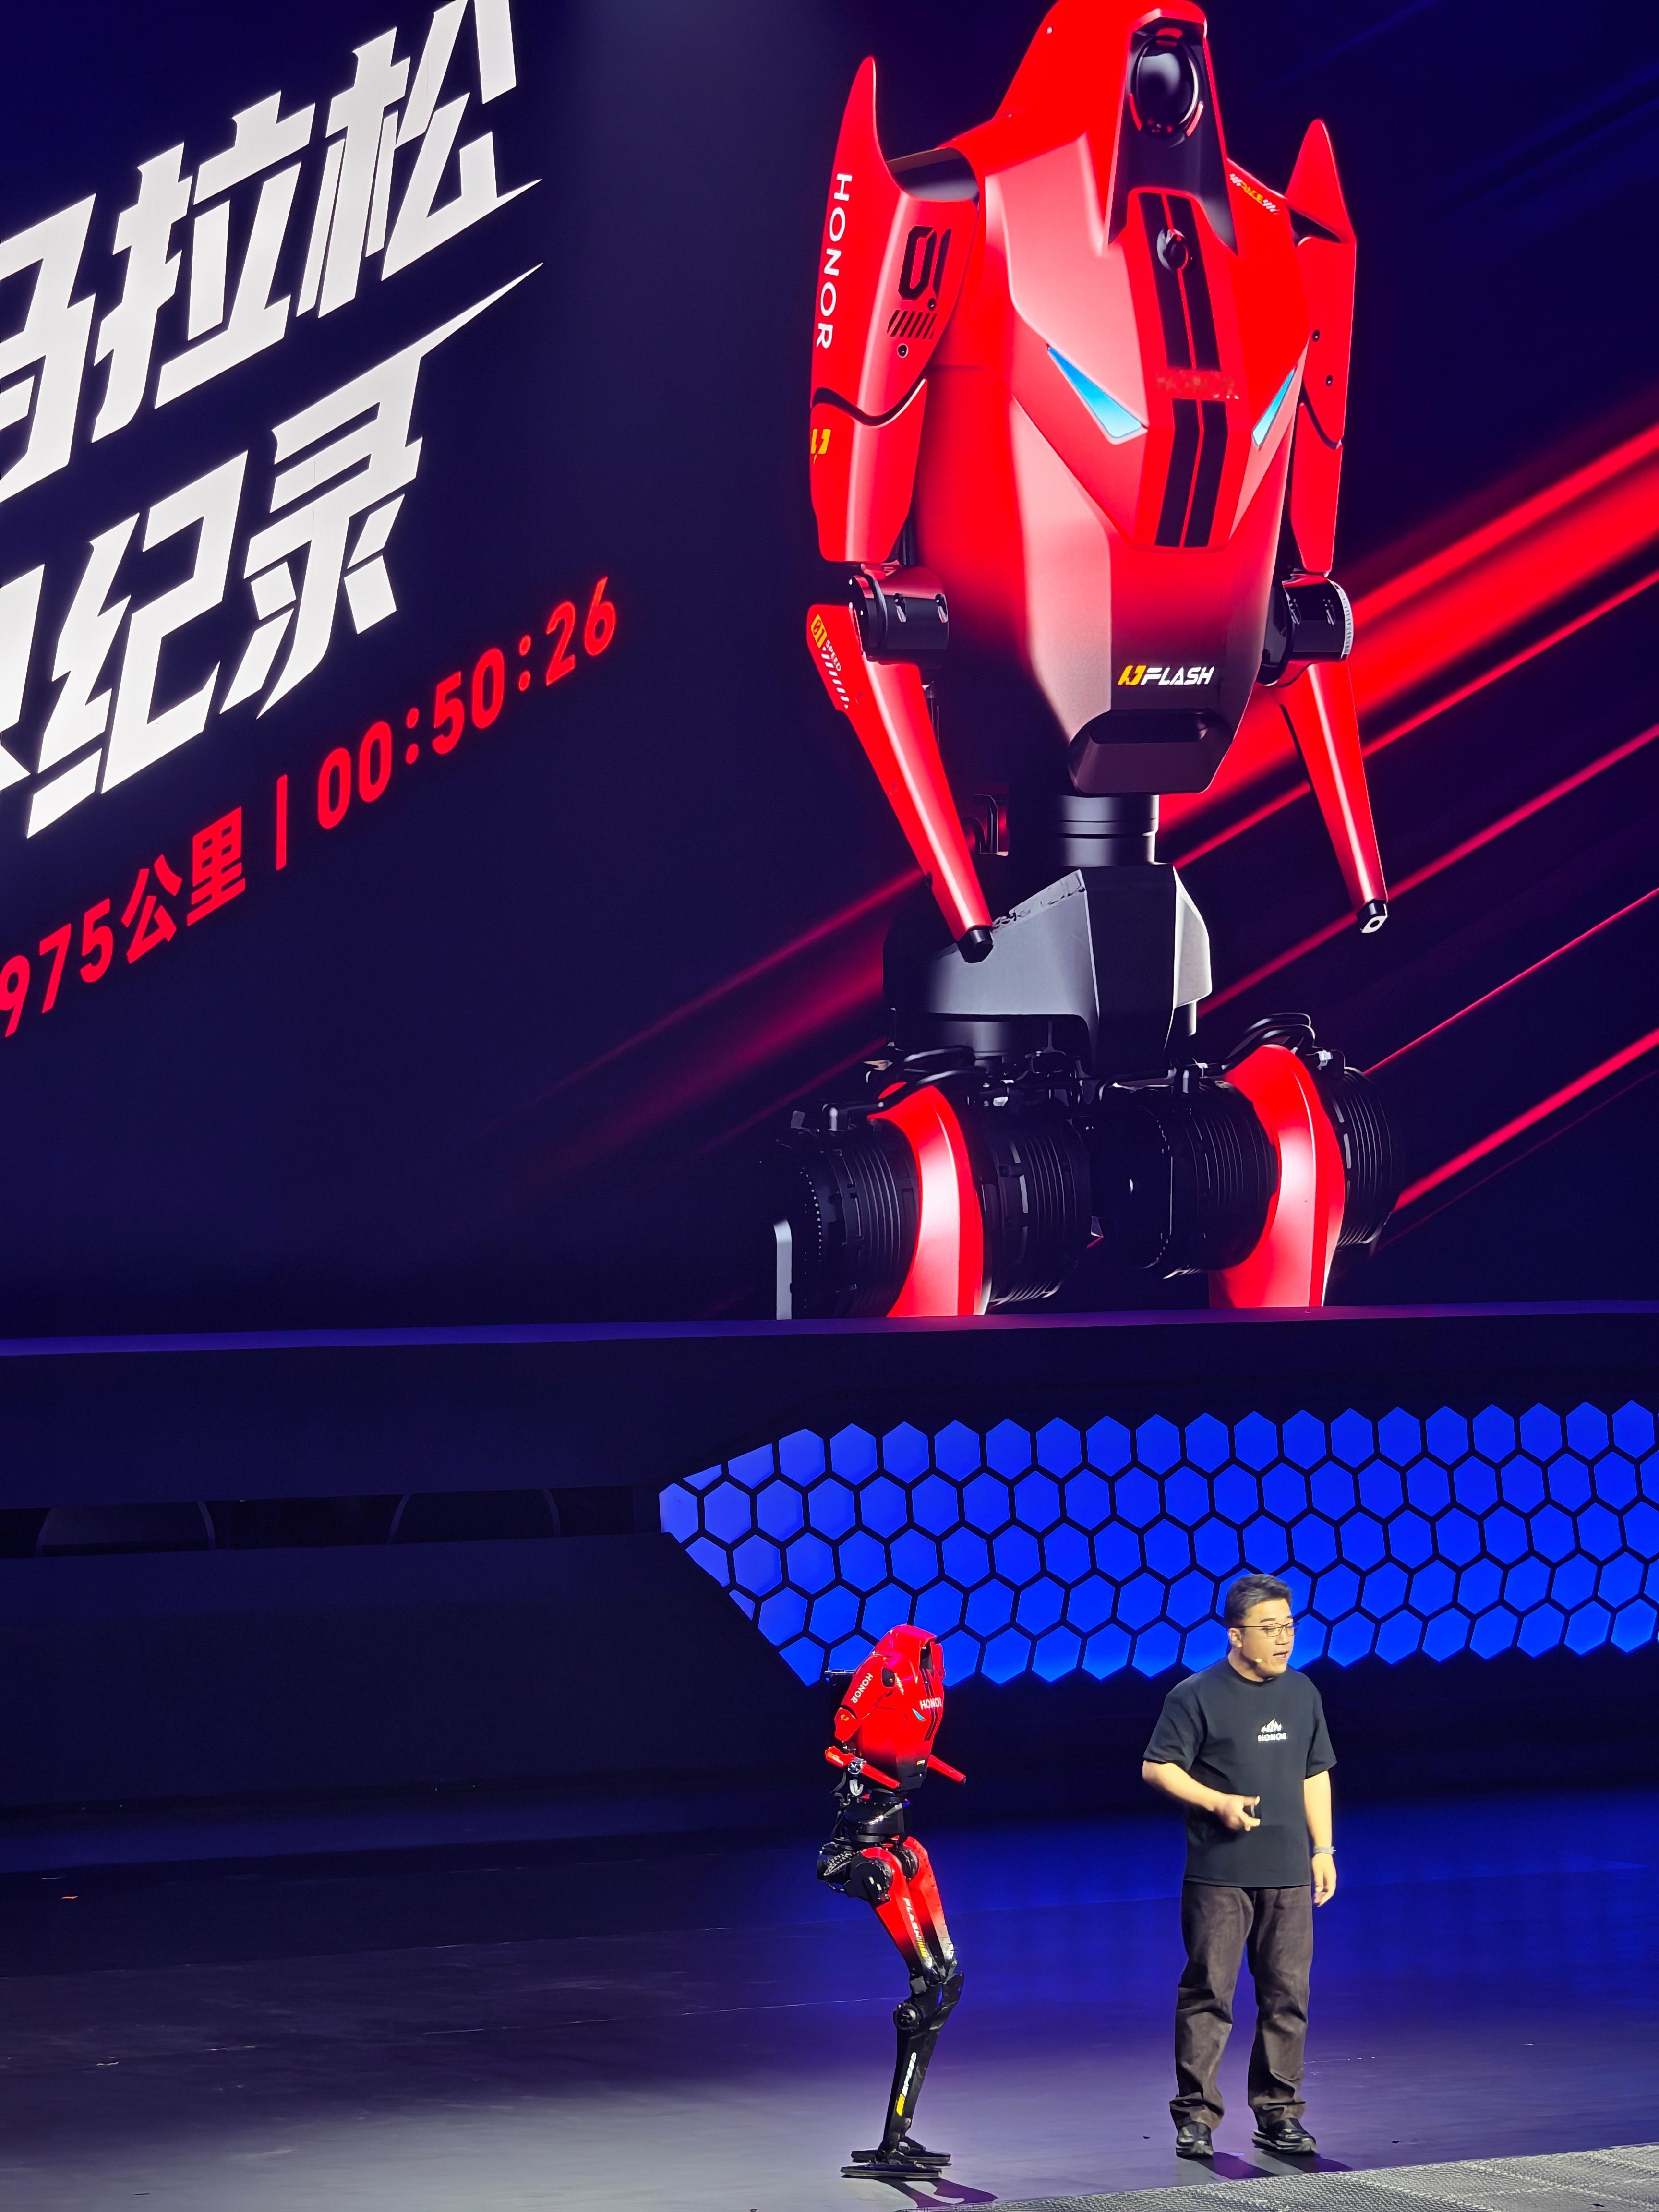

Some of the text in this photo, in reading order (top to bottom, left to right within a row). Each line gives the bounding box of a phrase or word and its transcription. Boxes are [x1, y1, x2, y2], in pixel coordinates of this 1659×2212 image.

[817, 173, 853, 349] HONOR
[0, 262, 543, 839] 纪录
[317, 576, 617, 829] 00:50:26
[1140, 666, 1215, 685] FLASH
[850, 1672, 874, 1703] HONOR
